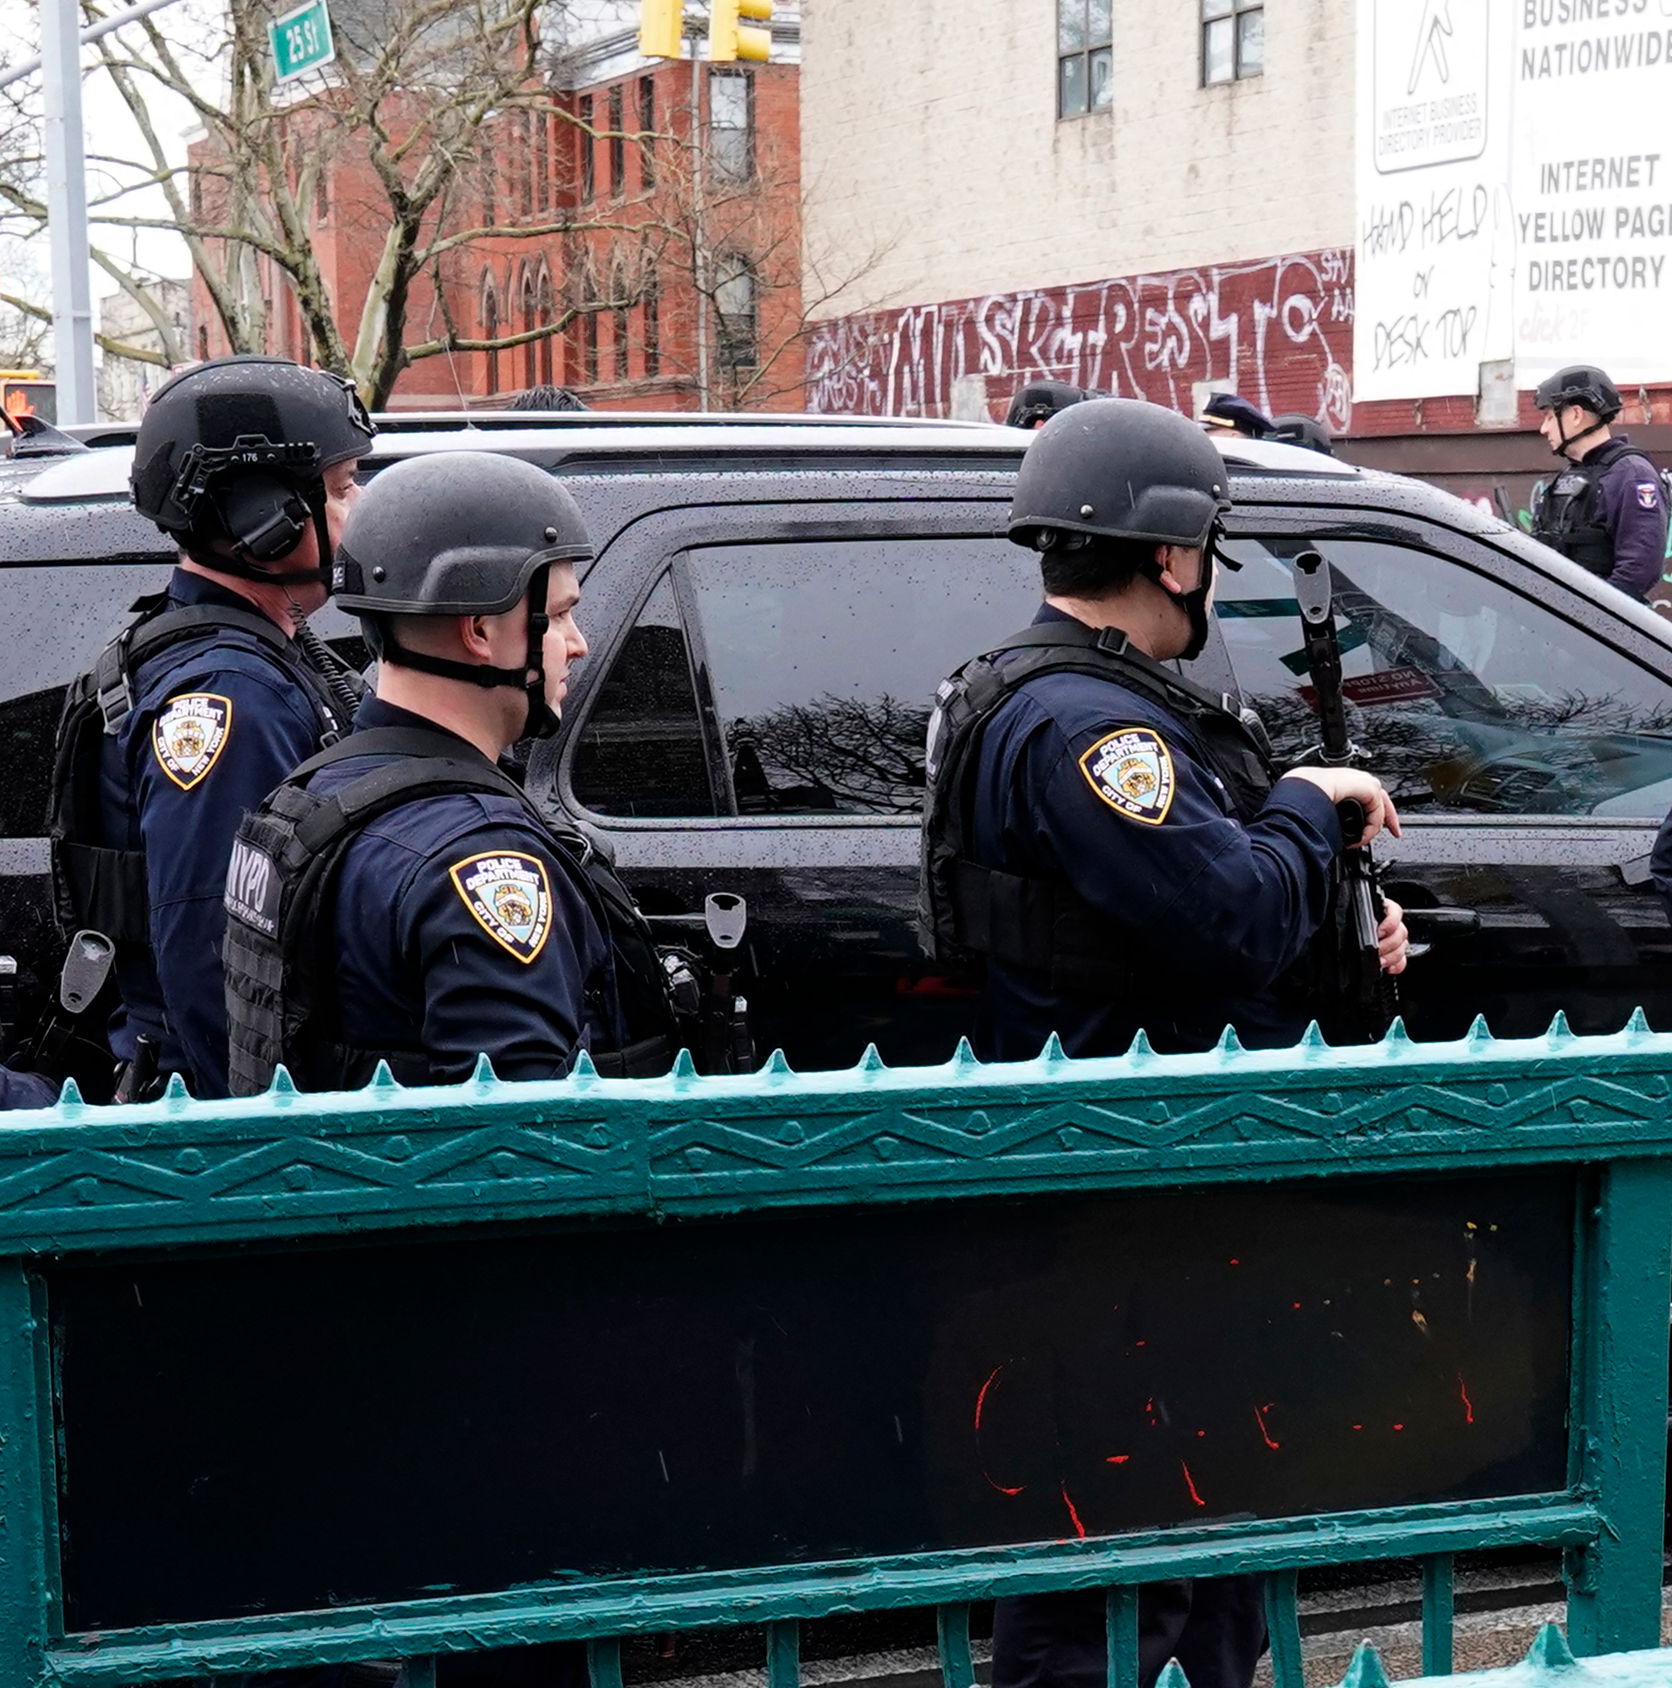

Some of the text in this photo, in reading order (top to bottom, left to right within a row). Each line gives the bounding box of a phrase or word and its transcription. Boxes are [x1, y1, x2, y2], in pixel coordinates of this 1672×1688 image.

[285, 25, 305, 63] 25
[1383, 102, 1427, 130] INTERNET
[1540, 154, 1661, 195] INTERNET
[1422, 184, 1488, 250] HELD
[1517, 208, 1605, 245] YELLOW
[1528, 255, 1666, 292] DIRECTORY
[1373, 305, 1477, 373] DESK TOP
[243, 453, 258, 462] 176
[1092, 742, 1159, 777] DEPARTMENT
[1099, 733, 1141, 758] POLICE
[1102, 785, 1143, 813] CITY OF
[226, 840, 270, 913] NYPD
[465, 869, 540, 890] DEPARTMENT
[476, 858, 523, 873] POLICE
[473, 901, 515, 943] CITY OF
